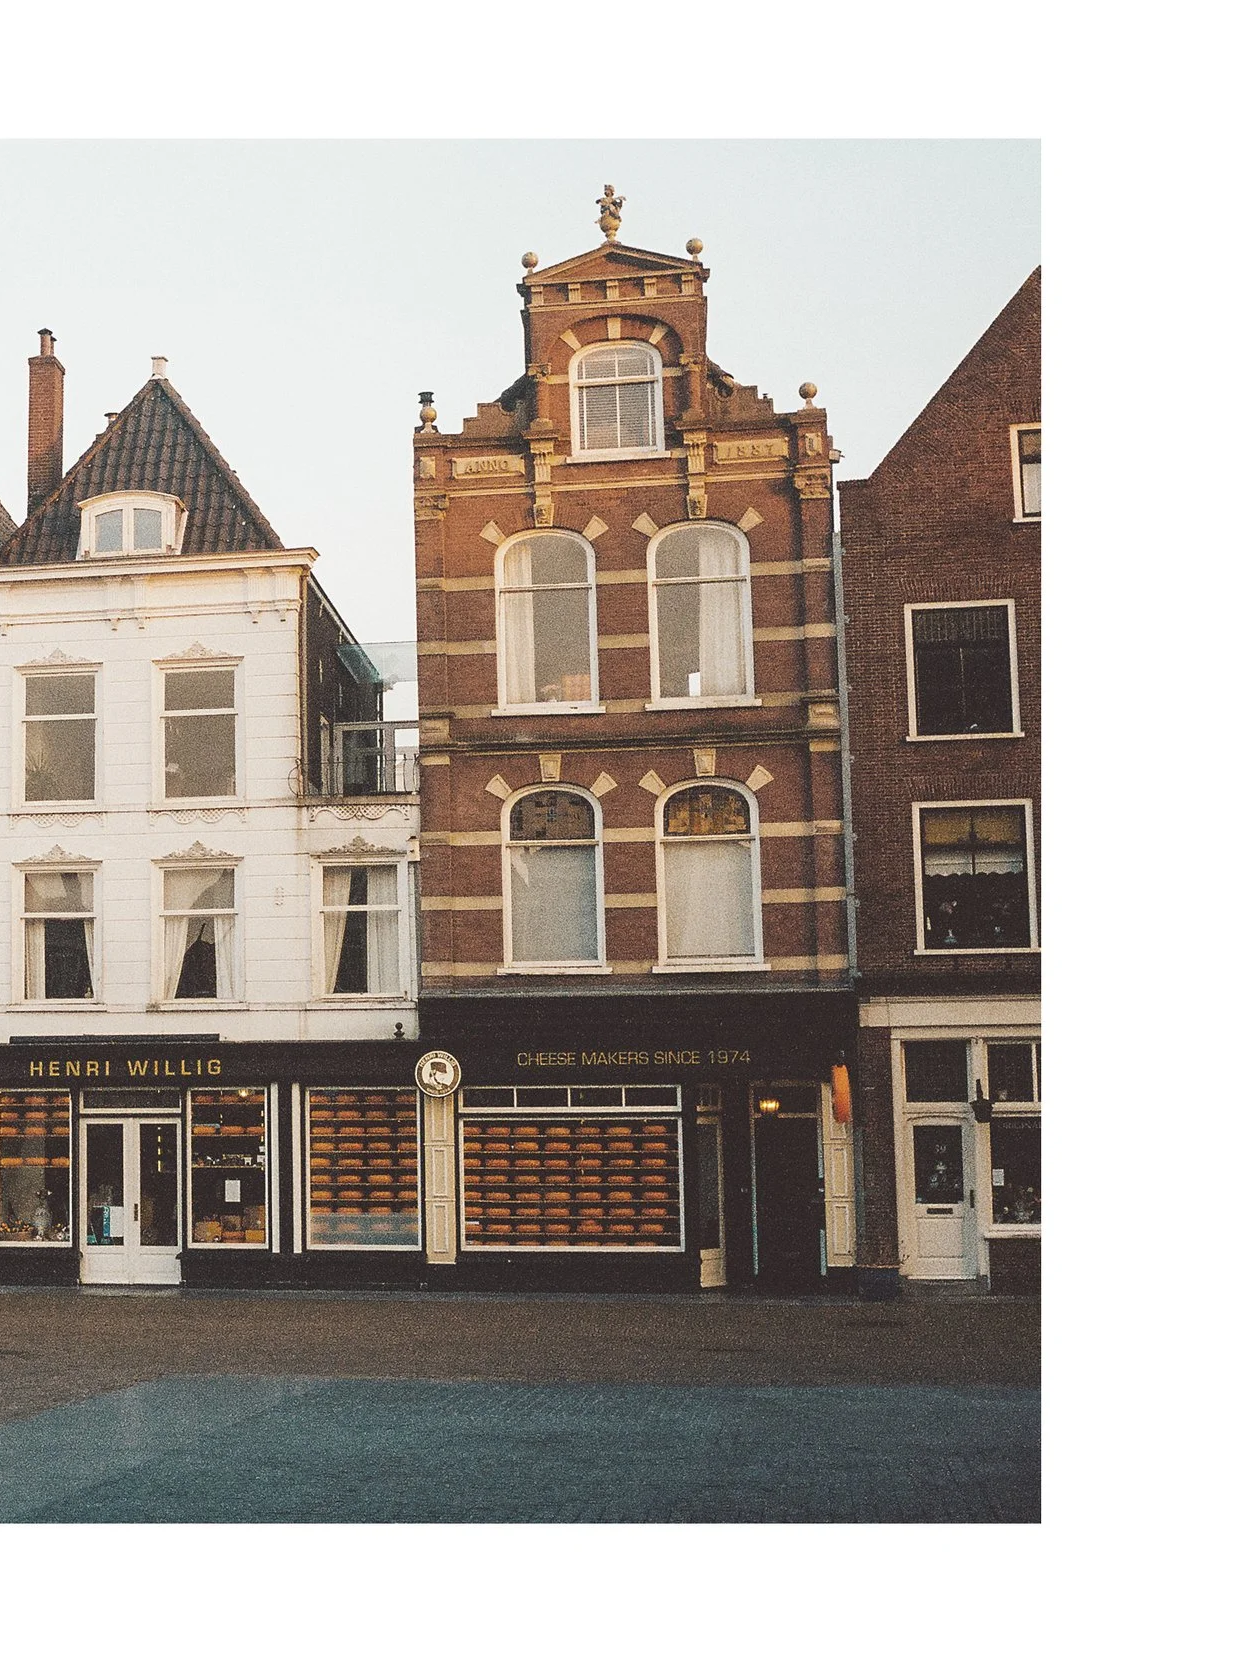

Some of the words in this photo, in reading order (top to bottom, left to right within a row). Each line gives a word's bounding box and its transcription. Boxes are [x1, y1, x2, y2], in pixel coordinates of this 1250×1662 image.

[464, 460, 509, 474] ANNO
[517, 1052, 576, 1066] CHEESE
[581, 1051, 649, 1066] MAKERS
[654, 1050, 701, 1065] SINCE
[707, 1049, 751, 1064] 1974
[29, 1060, 111, 1077] HENRI
[126, 1059, 222, 1076] WILLIG
